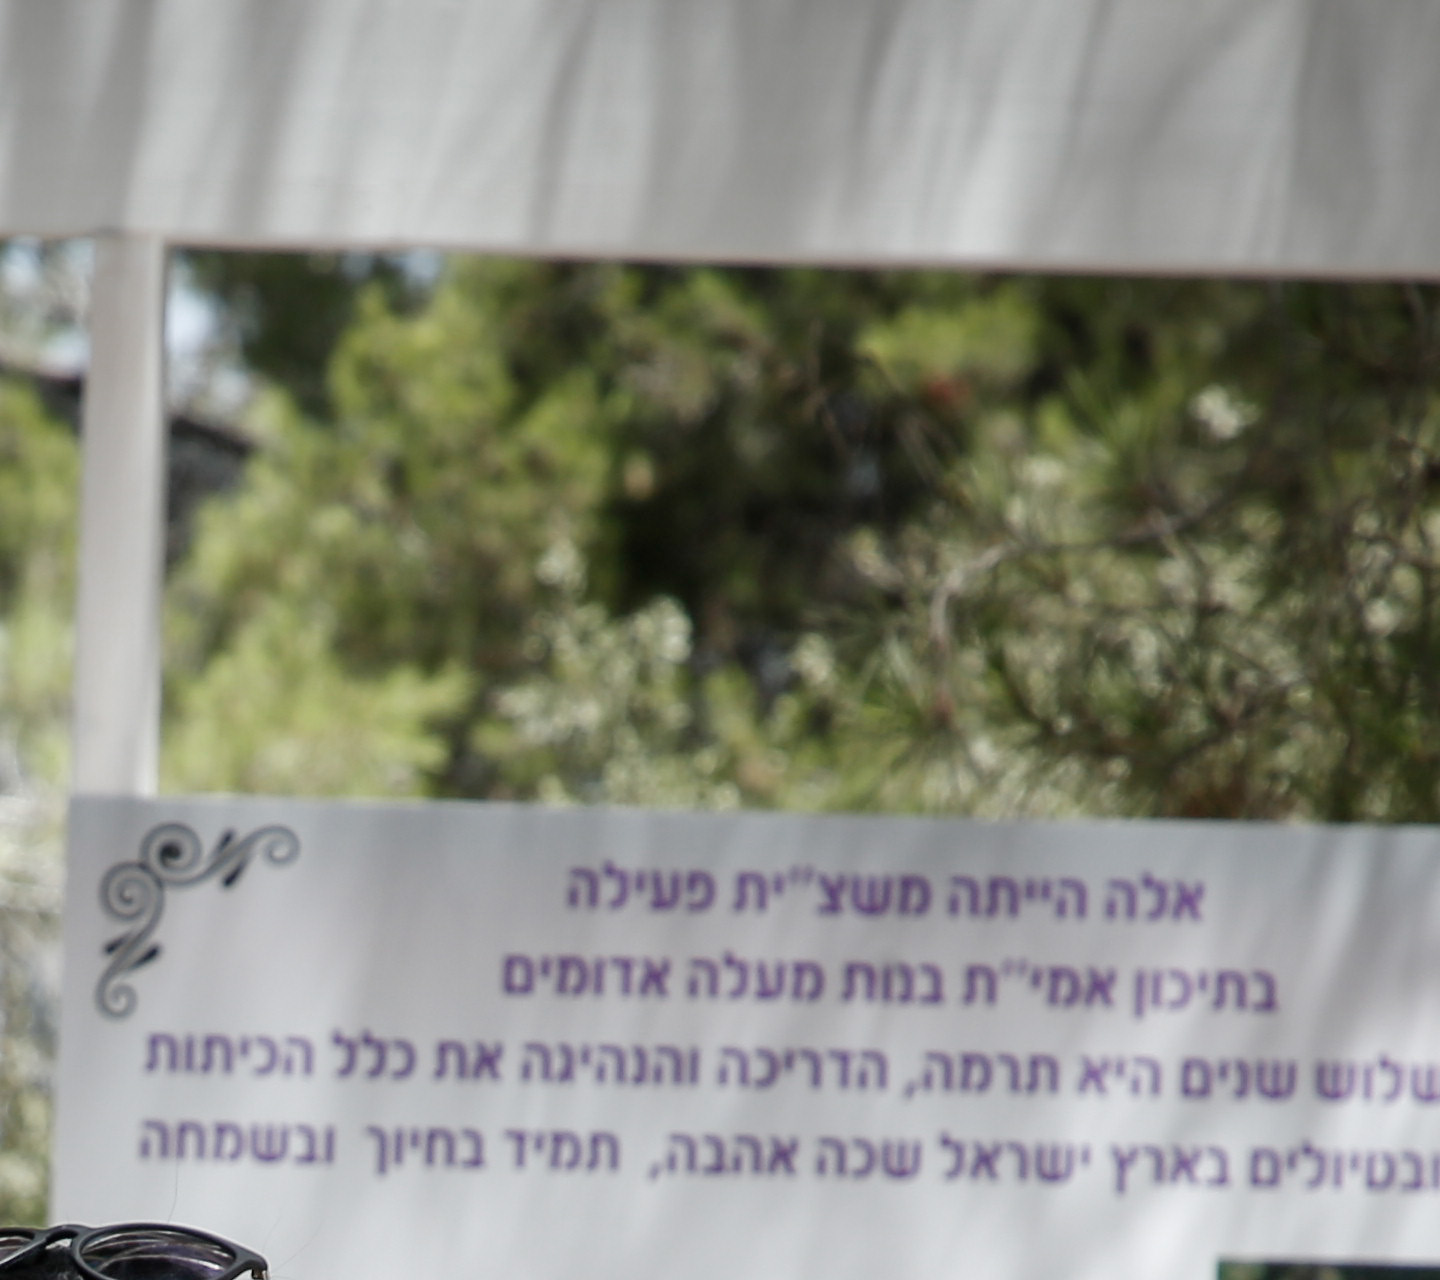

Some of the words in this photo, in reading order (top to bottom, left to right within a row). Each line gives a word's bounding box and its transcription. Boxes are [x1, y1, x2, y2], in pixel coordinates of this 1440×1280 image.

[566, 859, 717, 914] פעילה
[946, 875, 1089, 920] הייתה
[1106, 871, 1205, 922] אלה
[501, 953, 672, 999] אדומים
[686, 950, 827, 1003] מעלה
[840, 960, 946, 1005] בנות
[961, 959, 1118, 1009] אמי"ת
[1133, 968, 1281, 1020] בתיכון
[144, 1032, 315, 1077] הכיתות
[330, 1029, 418, 1081] כלל
[433, 1039, 504, 1081] את
[520, 1041, 701, 1086] והנהיגה
[716, 1045, 889, 1091] הדריכה
[902, 1050, 1061, 1100] תרמה,
[1076, 1055, 1163, 1097] היא
[1179, 1056, 1297, 1101] שנים
[138, 1119, 336, 1166] ובשמחה
[365, 1124, 486, 1177] בחיוך
[503, 1128, 621, 1172] תמיד
[648, 1132, 800, 1181] אהבה,
[815, 1136, 922, 1181] שכה
[938, 1131, 1092, 1185] ישראל
[1110, 1145, 1232, 1197] בארץ
